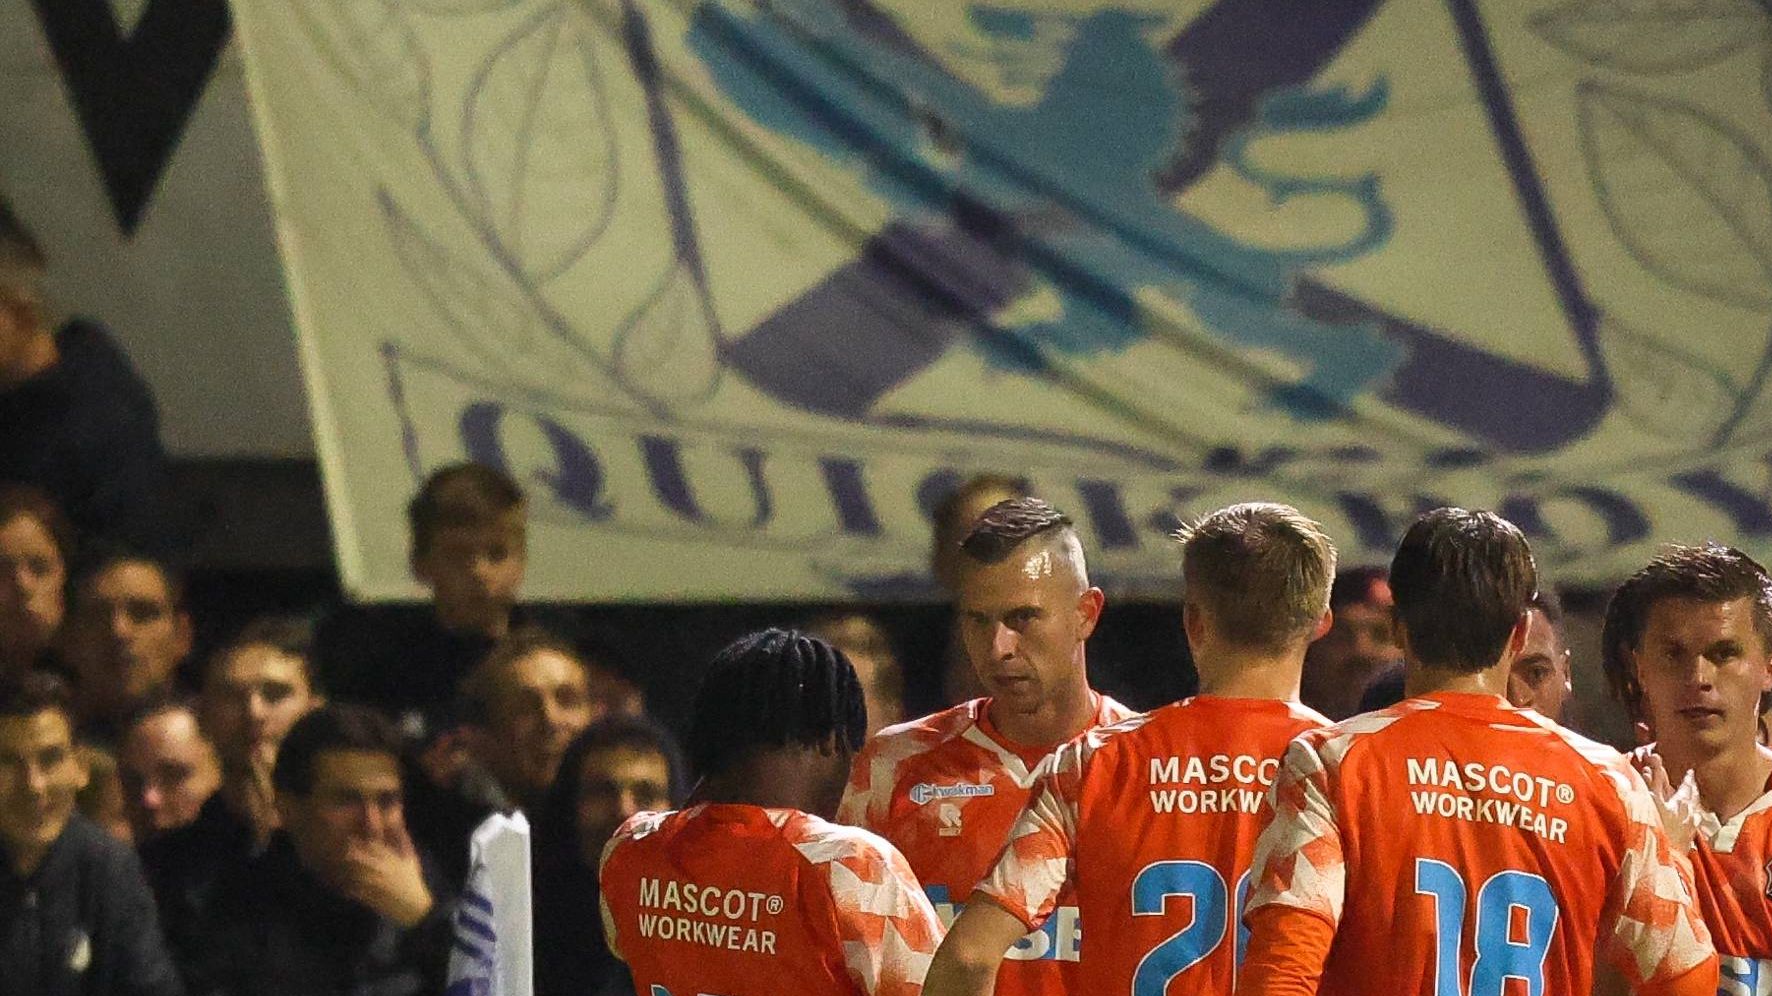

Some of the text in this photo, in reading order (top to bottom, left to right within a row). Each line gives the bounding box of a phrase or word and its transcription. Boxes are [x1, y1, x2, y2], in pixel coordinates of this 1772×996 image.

[1149, 754, 1280, 786] MASCO
[1149, 787, 1264, 815] WORKW
[1411, 791, 1569, 843] WORKWEAR
[638, 913, 777, 956] WORKWEAR
